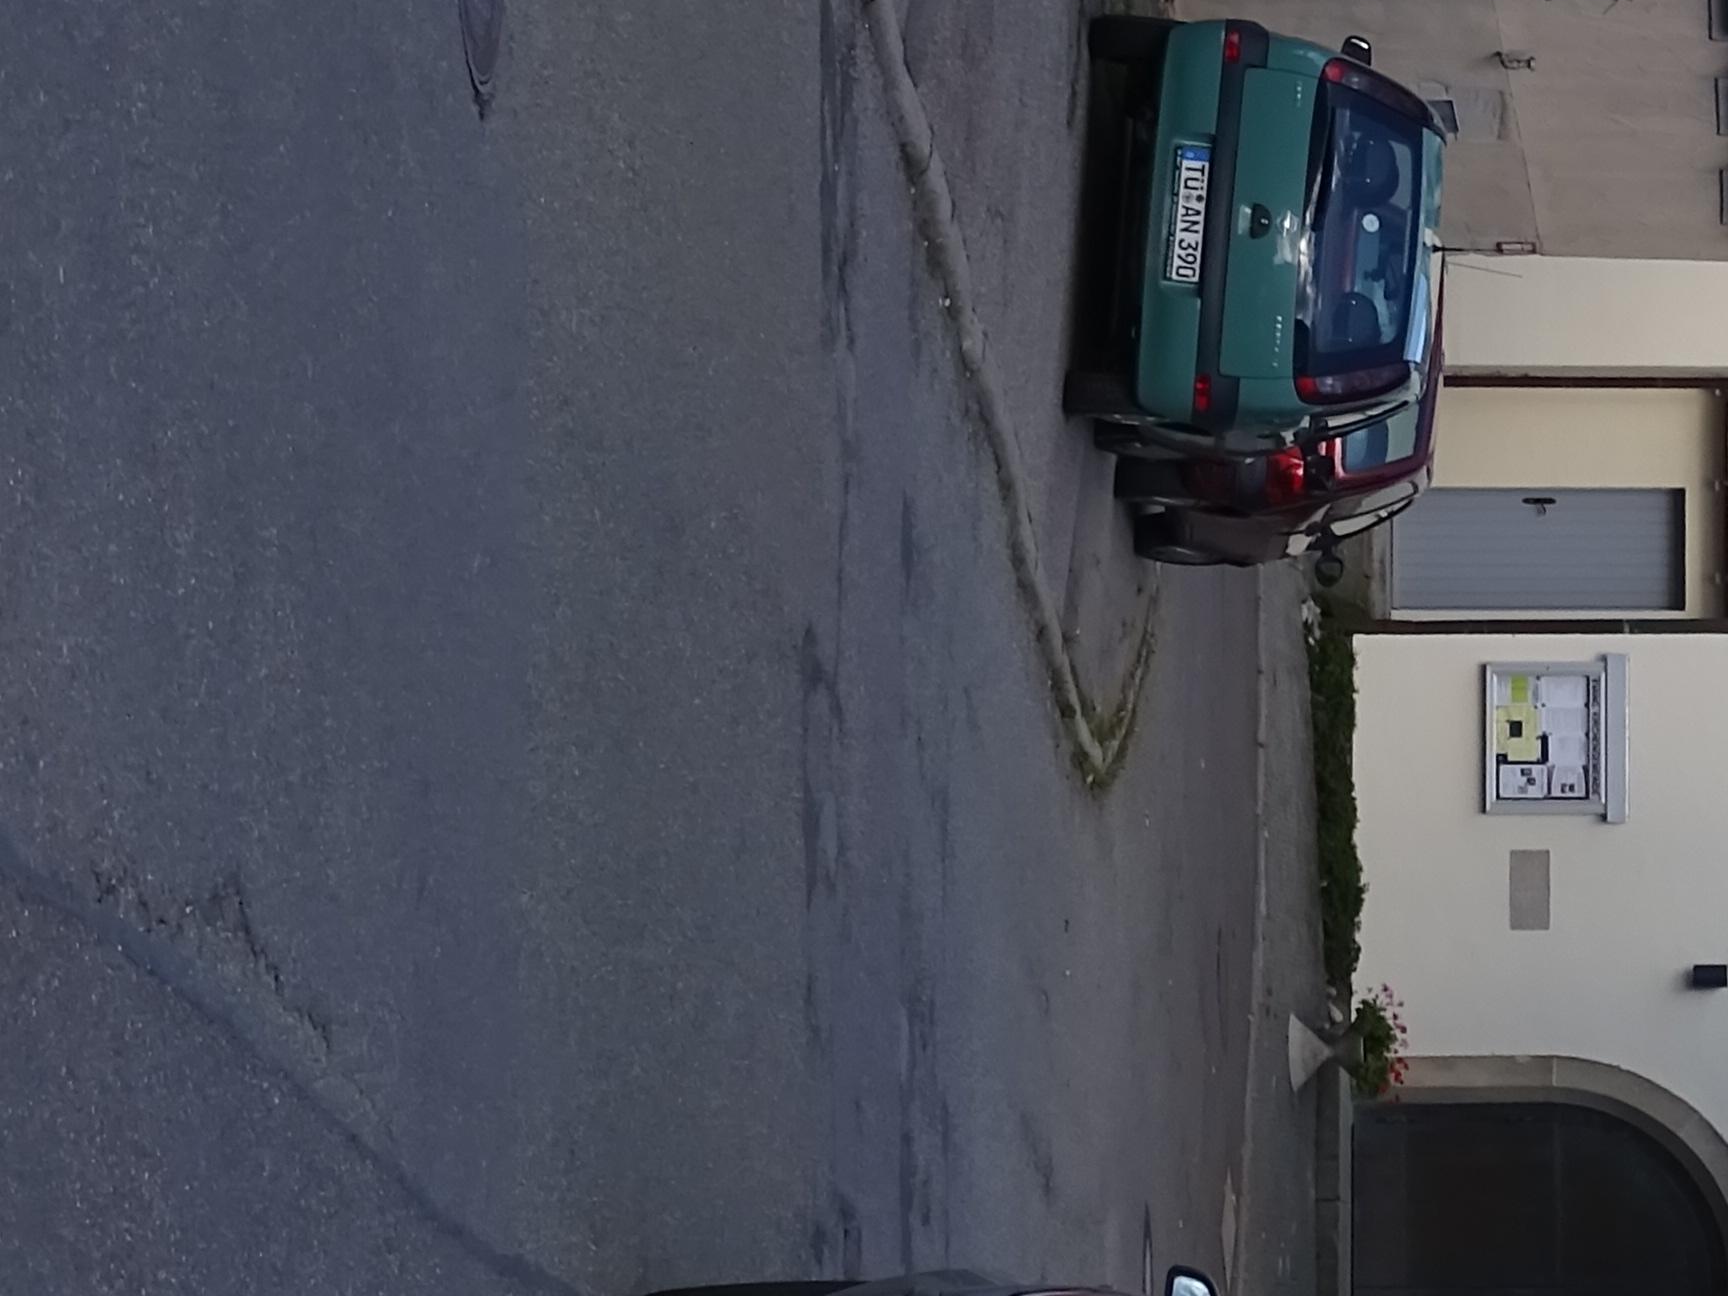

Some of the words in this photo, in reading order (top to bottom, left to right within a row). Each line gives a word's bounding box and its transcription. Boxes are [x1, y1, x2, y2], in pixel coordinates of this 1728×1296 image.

[1184, 164, 1205, 191] TÜ
[1179, 205, 1202, 235] AN
[1175, 238, 1199, 279] 390
